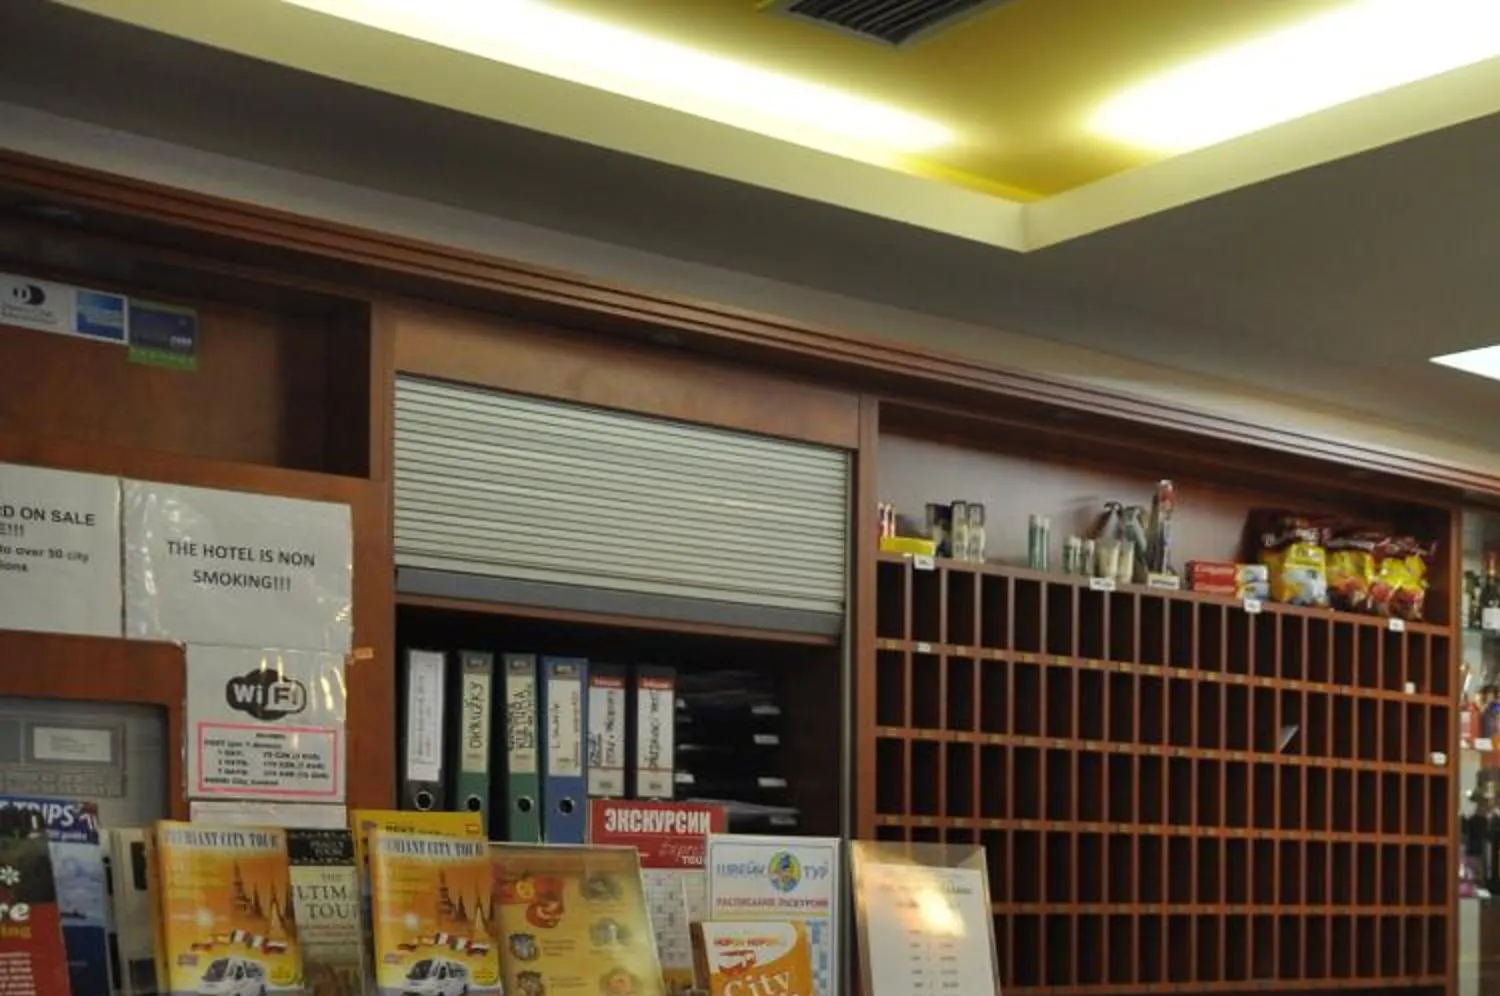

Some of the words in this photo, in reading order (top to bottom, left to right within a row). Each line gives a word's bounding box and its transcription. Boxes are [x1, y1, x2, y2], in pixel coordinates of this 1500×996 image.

[0, 505, 15, 518] D
[20, 506, 45, 521] ON
[51, 509, 96, 526] SALE
[167, 541, 198, 556] THE
[203, 543, 254, 562] HOTEL
[260, 549, 273, 563] IS
[278, 551, 315, 567] NON
[193, 569, 291, 592] SMOKING!!!
[604, 808, 711, 834] ЭКСКУРСИИ
[681, 855, 705, 866] TOU
[294, 884, 351, 899] LTIM
